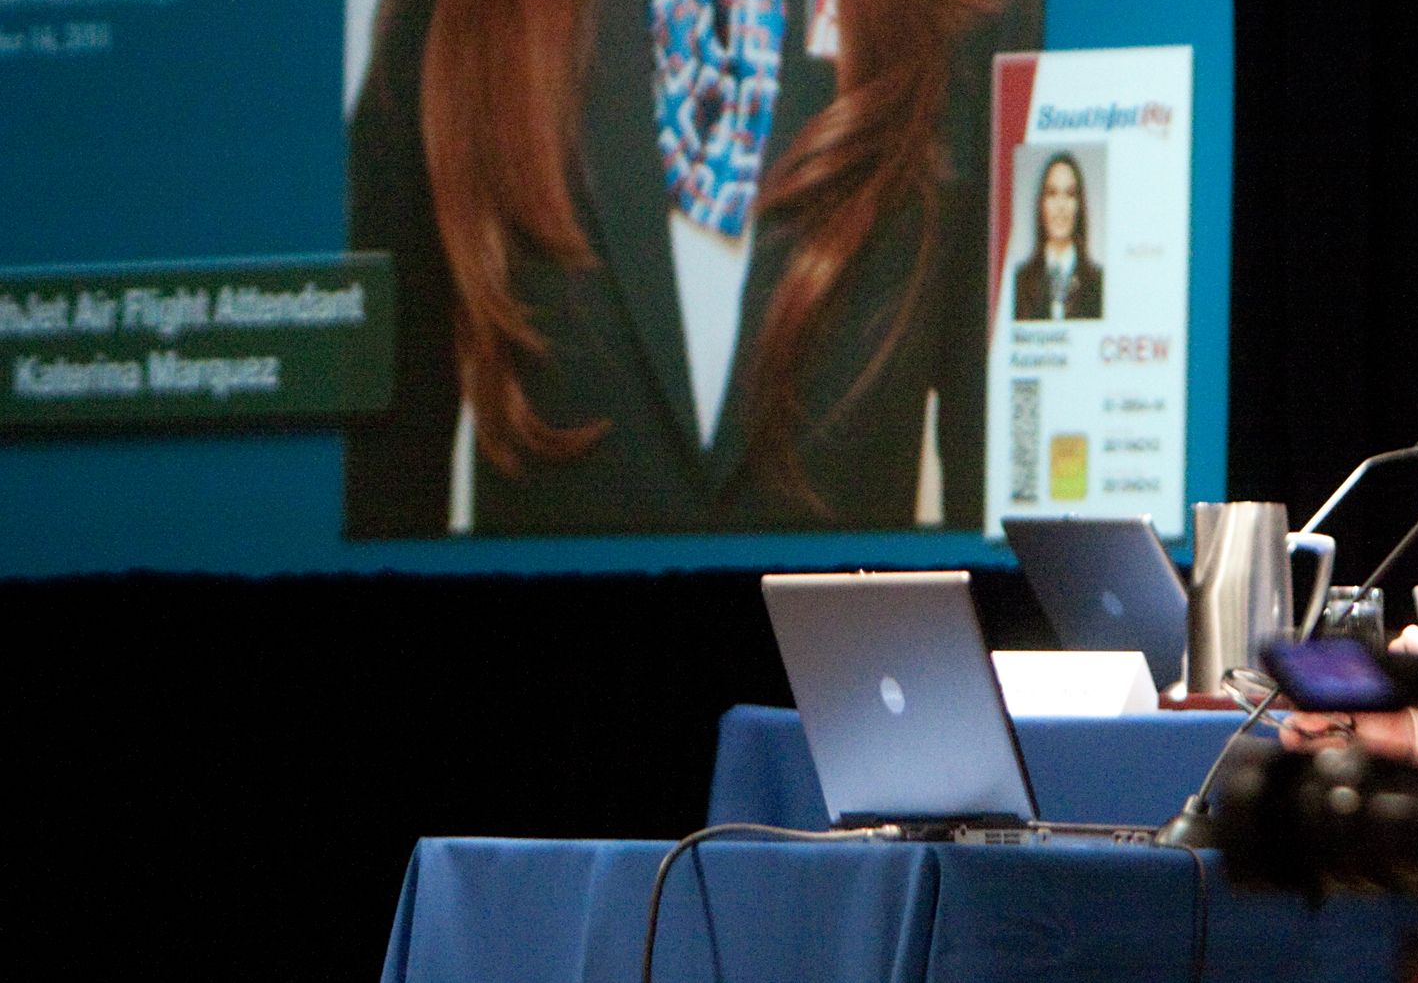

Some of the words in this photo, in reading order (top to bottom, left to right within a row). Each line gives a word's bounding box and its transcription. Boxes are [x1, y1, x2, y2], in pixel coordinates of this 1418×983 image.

[72, 289, 117, 331] Air
[122, 285, 210, 338] Flight
[214, 281, 365, 325] Attendant
[13, 352, 142, 396] Katerina
[147, 348, 282, 398] Marquez
[1100, 335, 1171, 363] CREW
